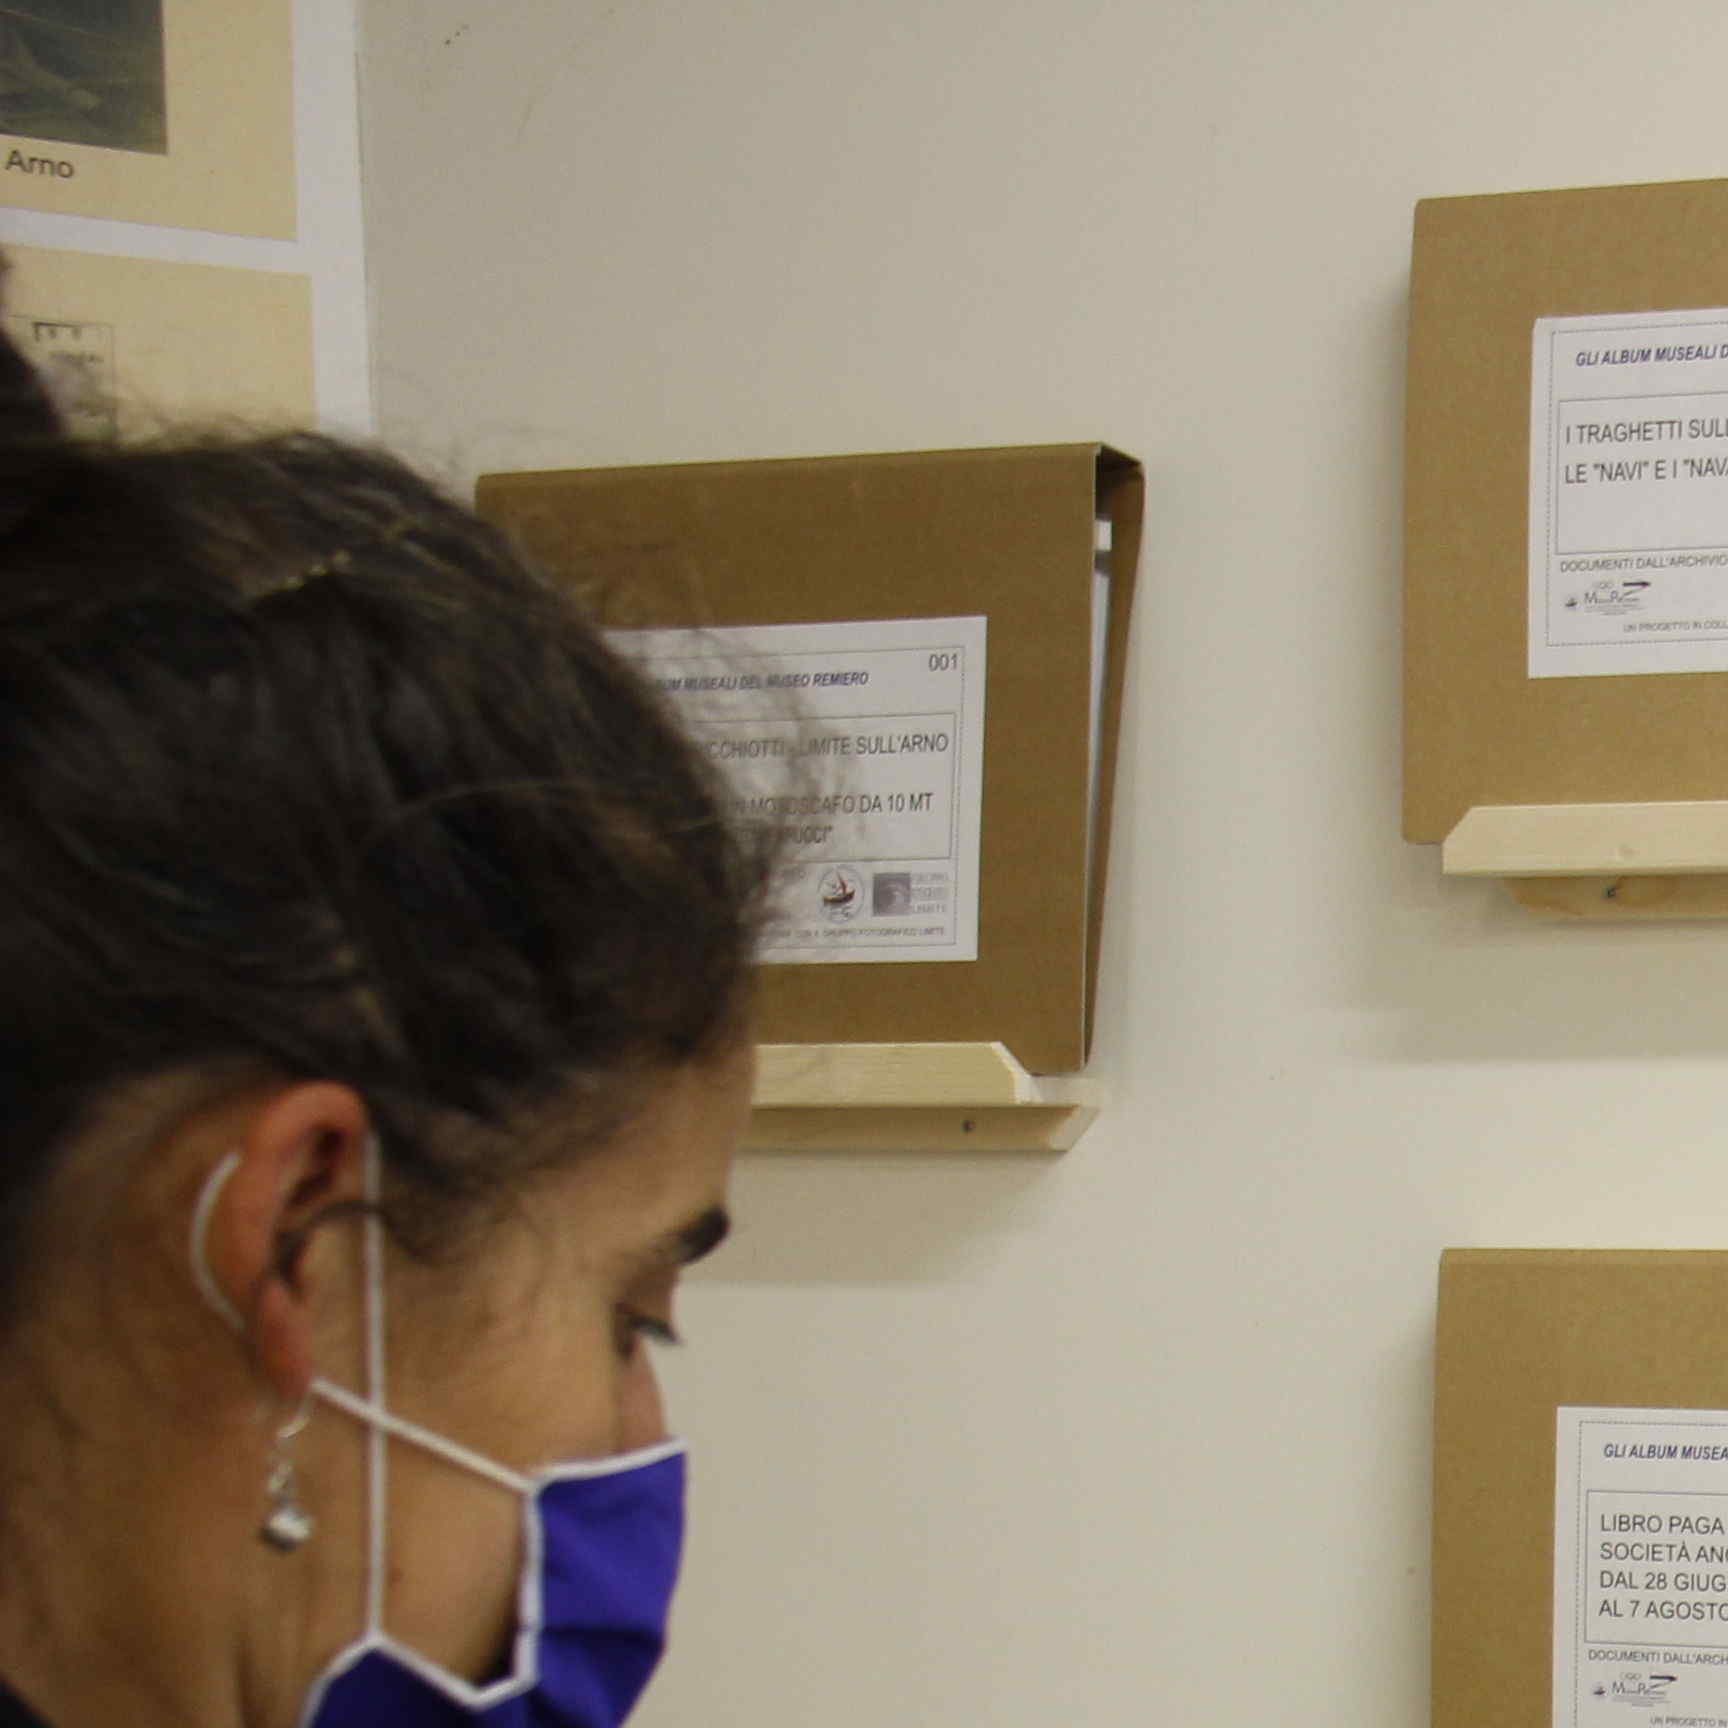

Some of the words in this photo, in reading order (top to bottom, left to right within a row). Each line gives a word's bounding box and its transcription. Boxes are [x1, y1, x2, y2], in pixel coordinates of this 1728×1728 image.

[5, 150, 74, 178] Arno
[1576, 351, 1598, 367] GLI
[1601, 348, 1651, 365] ALBUM
[1655, 344, 1717, 362] MUSEALI
[1577, 420, 1682, 443] TRAGHETTI
[1565, 464, 1587, 483] LE
[1594, 461, 1649, 481] "NAVI"
[1655, 461, 1665, 479] E
[1561, 558, 1632, 573] DOCUMENTI
[1636, 554, 1727, 570] DALL'ARCHIVIO
[929, 654, 957, 671] 001
[856, 734, 948, 754] SULL'ARNO
[860, 797, 882, 814] DA
[887, 796, 905, 812] 10
[909, 793, 933, 811] MT
[1601, 1514, 1662, 1534] LIBRO
[1668, 1516, 1725, 1535] PAGA
[1600, 1540, 1690, 1563] SOCIETÀ
[1600, 1571, 1639, 1590] DAL
[1644, 1571, 1667, 1591] 28
[1599, 1600, 1624, 1618] AL
[1630, 1600, 1641, 1618] 7
